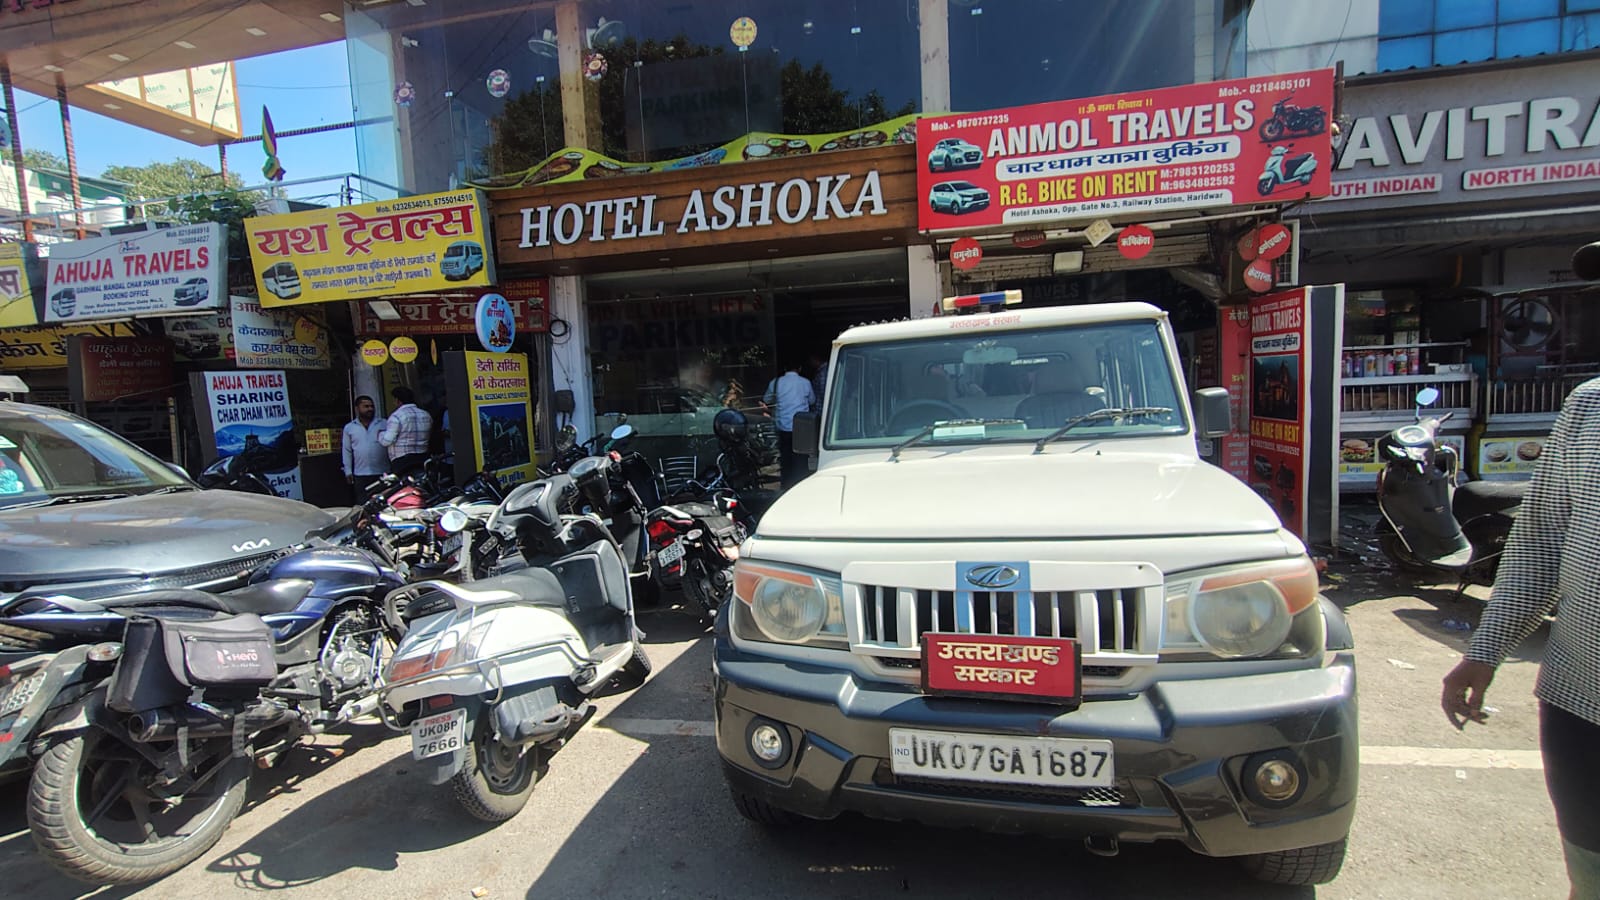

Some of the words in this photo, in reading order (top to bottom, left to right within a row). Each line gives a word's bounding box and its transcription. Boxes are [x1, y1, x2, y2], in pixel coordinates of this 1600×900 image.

[957, 114, 1009, 128] 9870737235
[987, 118, 1098, 158] ANMOL
[1107, 99, 1255, 144] TRAVELS
[1336, 96, 1600, 170] AVITR
[1006, 161, 1047, 173] चार
[1048, 155, 1095, 170] धाम
[1096, 149, 1149, 165] यात्रा
[1152, 139, 1230, 163] बुकिंग
[1469, 168, 1536, 187] NORTH
[1542, 160, 1600, 182] INDIA
[1000, 183, 1033, 206] R.G.
[1038, 178, 1077, 202] BIKE
[1082, 175, 1106, 198] ON
[1112, 170, 1157, 195] RENT
[1331, 182, 1367, 198] UTH
[1373, 176, 1436, 194] INDIAN
[518, 195, 665, 249] HOTEL
[676, 170, 888, 234] ASHOKA
[1011, 209, 1030, 217] Hotel
[1032, 207, 1060, 215] Ashoka,
[1081, 203, 1098, 211] Gate
[1122, 198, 1152, 207] Railway
[1187, 192, 1223, 201] Haridwar
[254, 224, 329, 256] यश
[336, 204, 475, 256] ट्रेवल्स
[54, 258, 114, 285] AHUJA
[123, 246, 209, 277] TRAVELS
[103, 291, 128, 301] BOOKING
[129, 289, 149, 298] OFFICE
[104, 282, 126, 291] MANDAL
[127, 280, 143, 289] CHAR
[144, 279, 160, 287] DHAM
[161, 277, 179, 285] YATRA
[1273, 307, 1301, 330] TRAVELS
[476, 359, 494, 371] डेली
[212, 375, 243, 391] AHUJA
[246, 374, 283, 389] TRAVELS
[473, 377, 485, 389] श्री
[488, 376, 527, 389] केदारनाथ
[216, 391, 284, 405] SHARING
[217, 407, 239, 423] CHAR
[241, 406, 263, 421] DHAM
[264, 404, 287, 419] YATRA
[937, 641, 1061, 666] उत्तराखण्ड
[953, 665, 1038, 685] सरकार
[419, 720, 458, 738] UK08P
[419, 737, 458, 755] 7666
[894, 747, 910, 757] IND
[911, 735, 1108, 778] UK07GA1687
